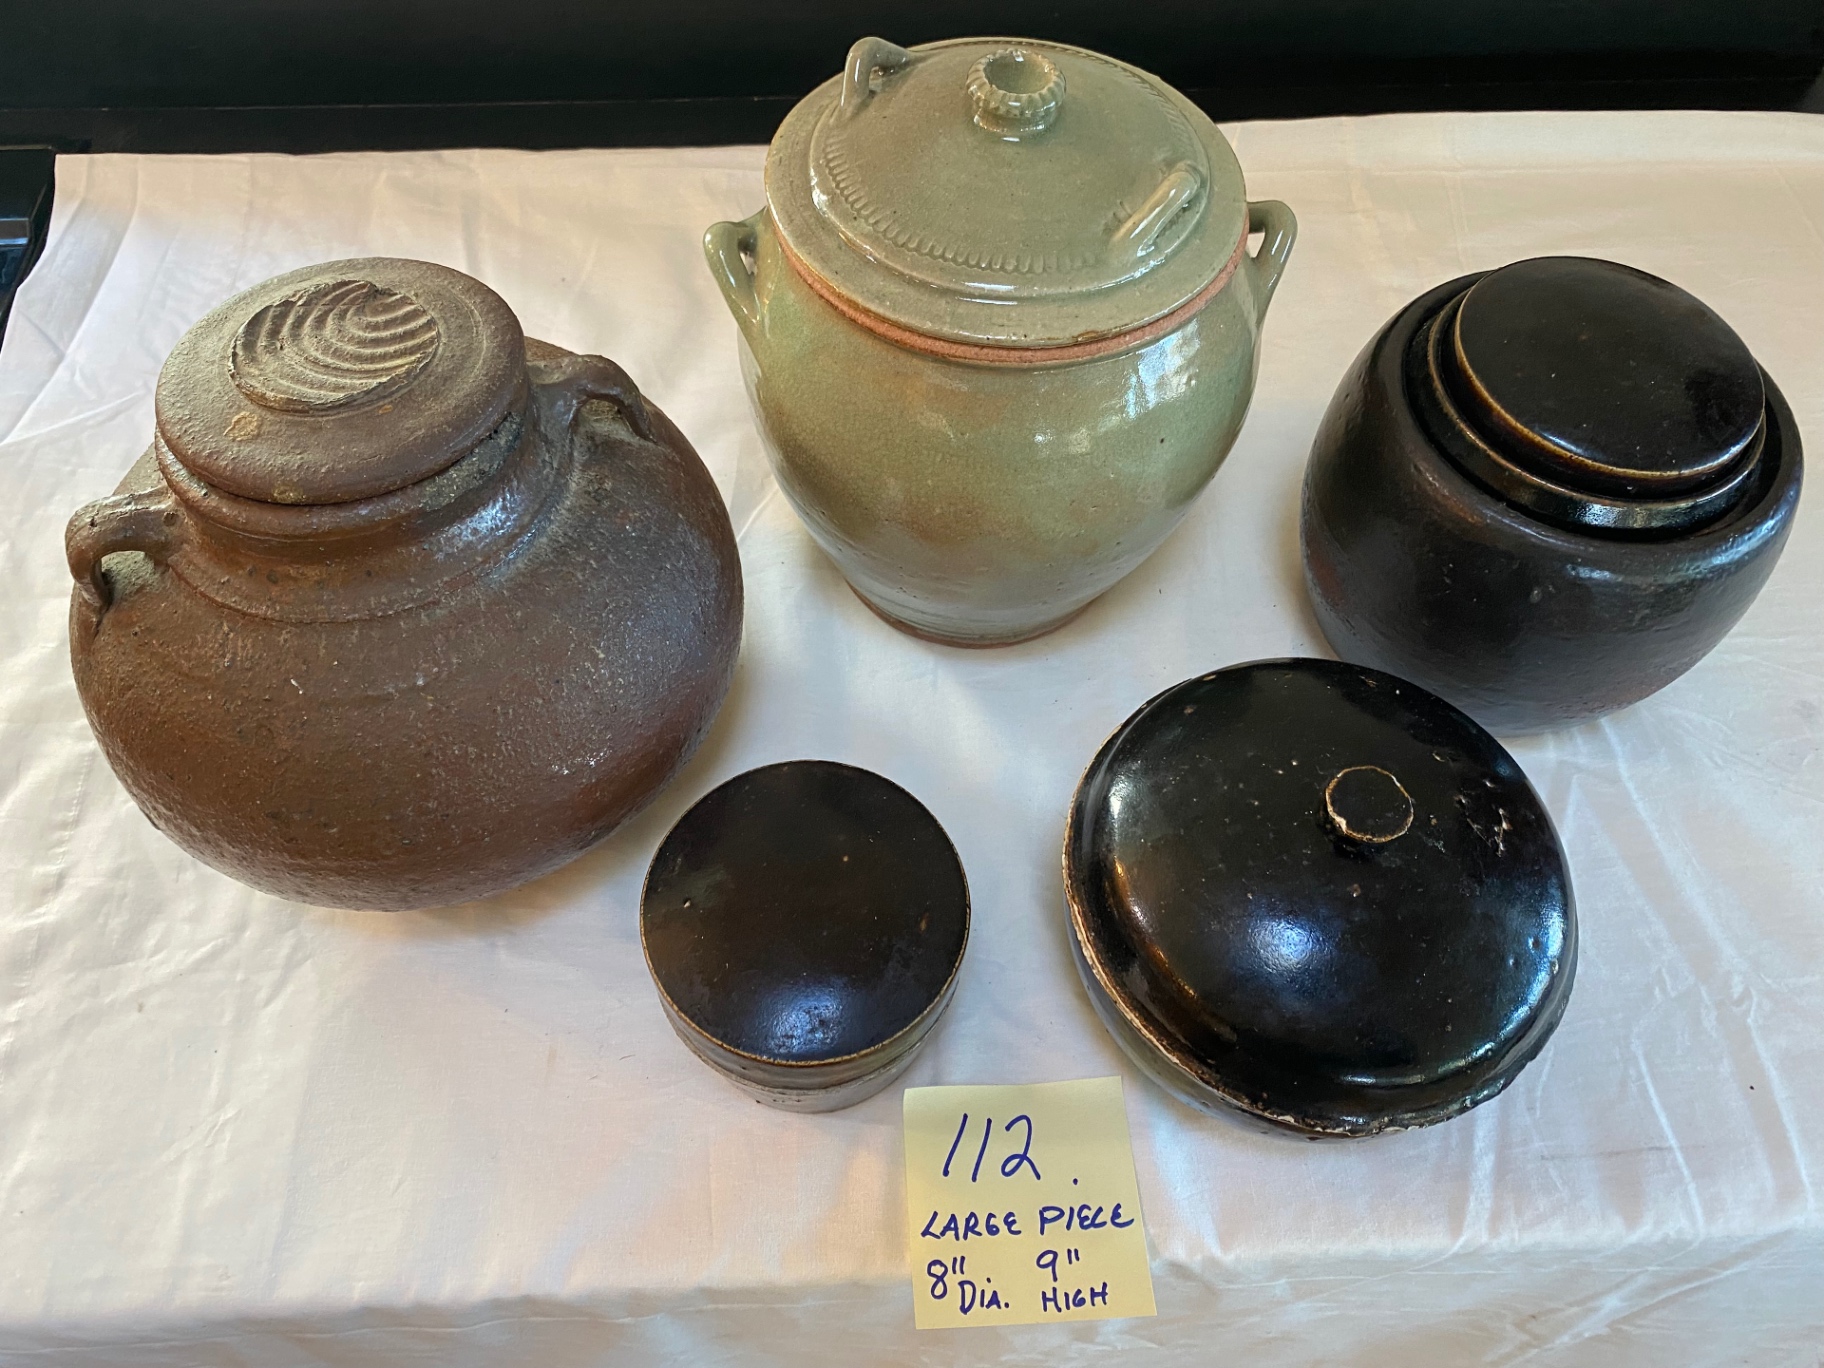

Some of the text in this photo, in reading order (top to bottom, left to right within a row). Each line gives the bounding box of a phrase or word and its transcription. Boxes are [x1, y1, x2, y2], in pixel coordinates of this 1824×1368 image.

[920, 1202, 1135, 1241] LARGE PIECE
[1041, 1281, 1109, 1313] HIGH
